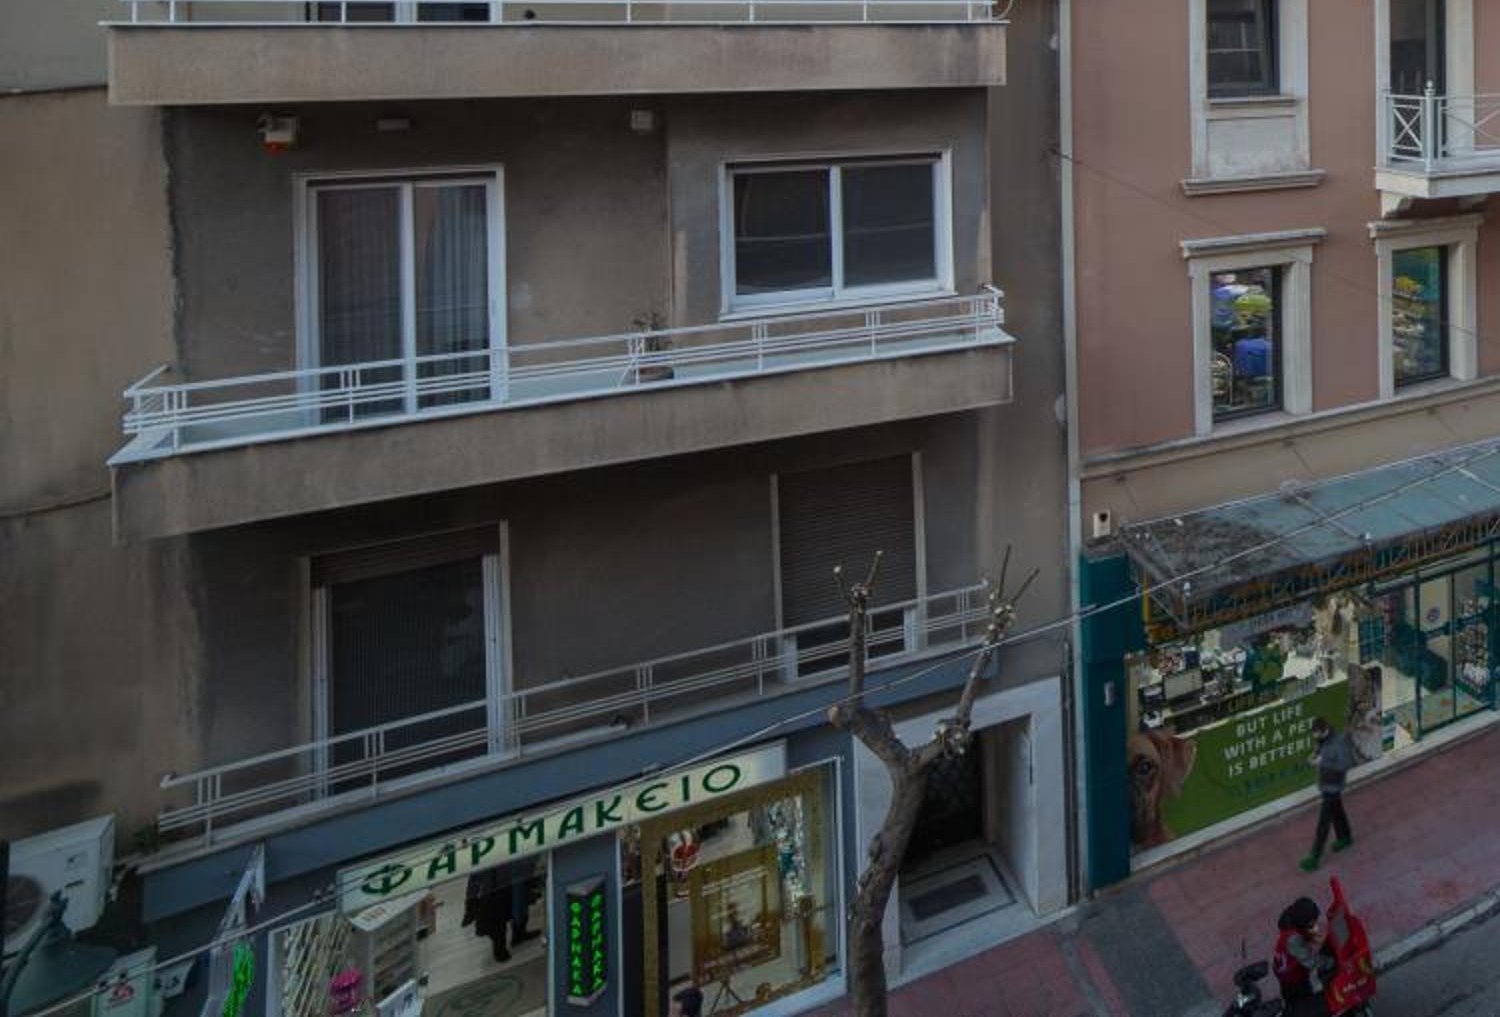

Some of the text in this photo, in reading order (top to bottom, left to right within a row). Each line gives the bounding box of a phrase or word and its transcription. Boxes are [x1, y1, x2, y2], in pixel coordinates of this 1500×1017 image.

[1224, 716, 1314, 760] WITH A PET
[1236, 702, 1304, 738] BUT LIFE
[1228, 735, 1311, 778] IS BETTER!
[361, 763, 742, 895] ΦΑΡΜΑΚΕΙΟ
